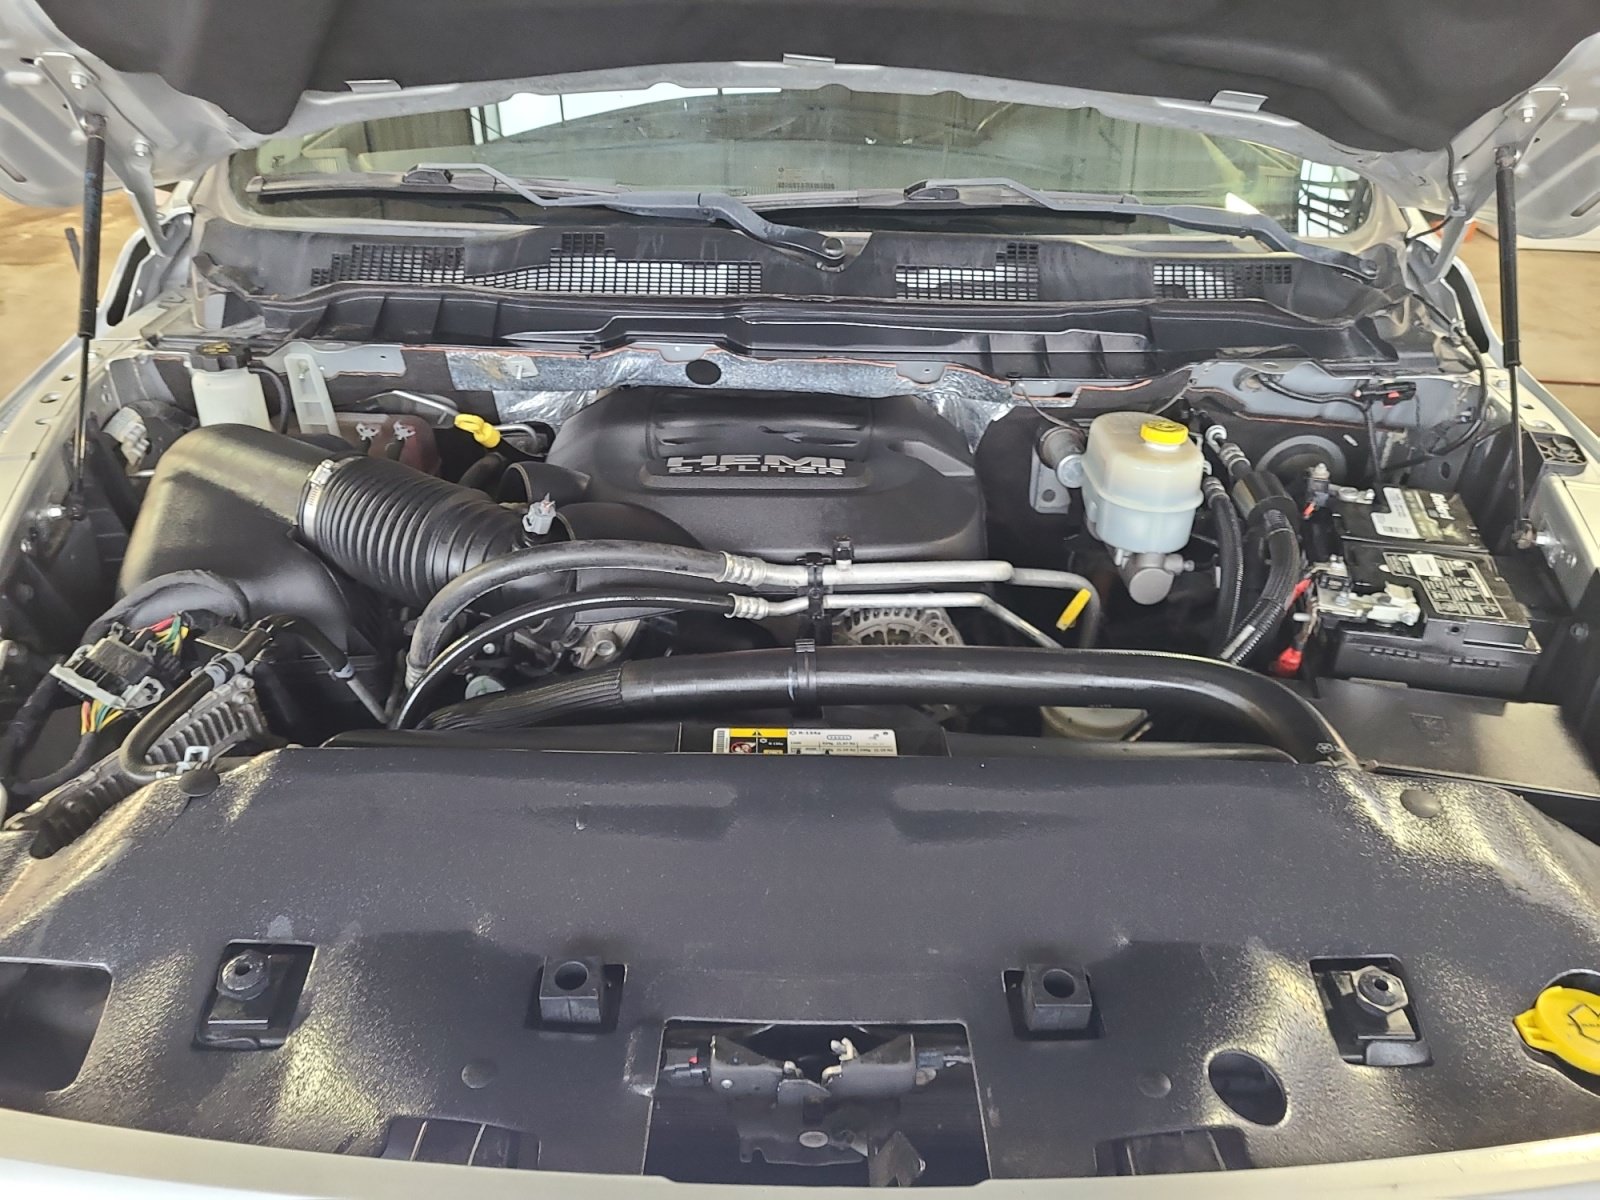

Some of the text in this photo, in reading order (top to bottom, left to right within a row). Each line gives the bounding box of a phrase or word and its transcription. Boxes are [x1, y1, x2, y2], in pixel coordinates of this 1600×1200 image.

[667, 454, 846, 469] HEMI
[669, 464, 844, 475] 6.4 LITER
